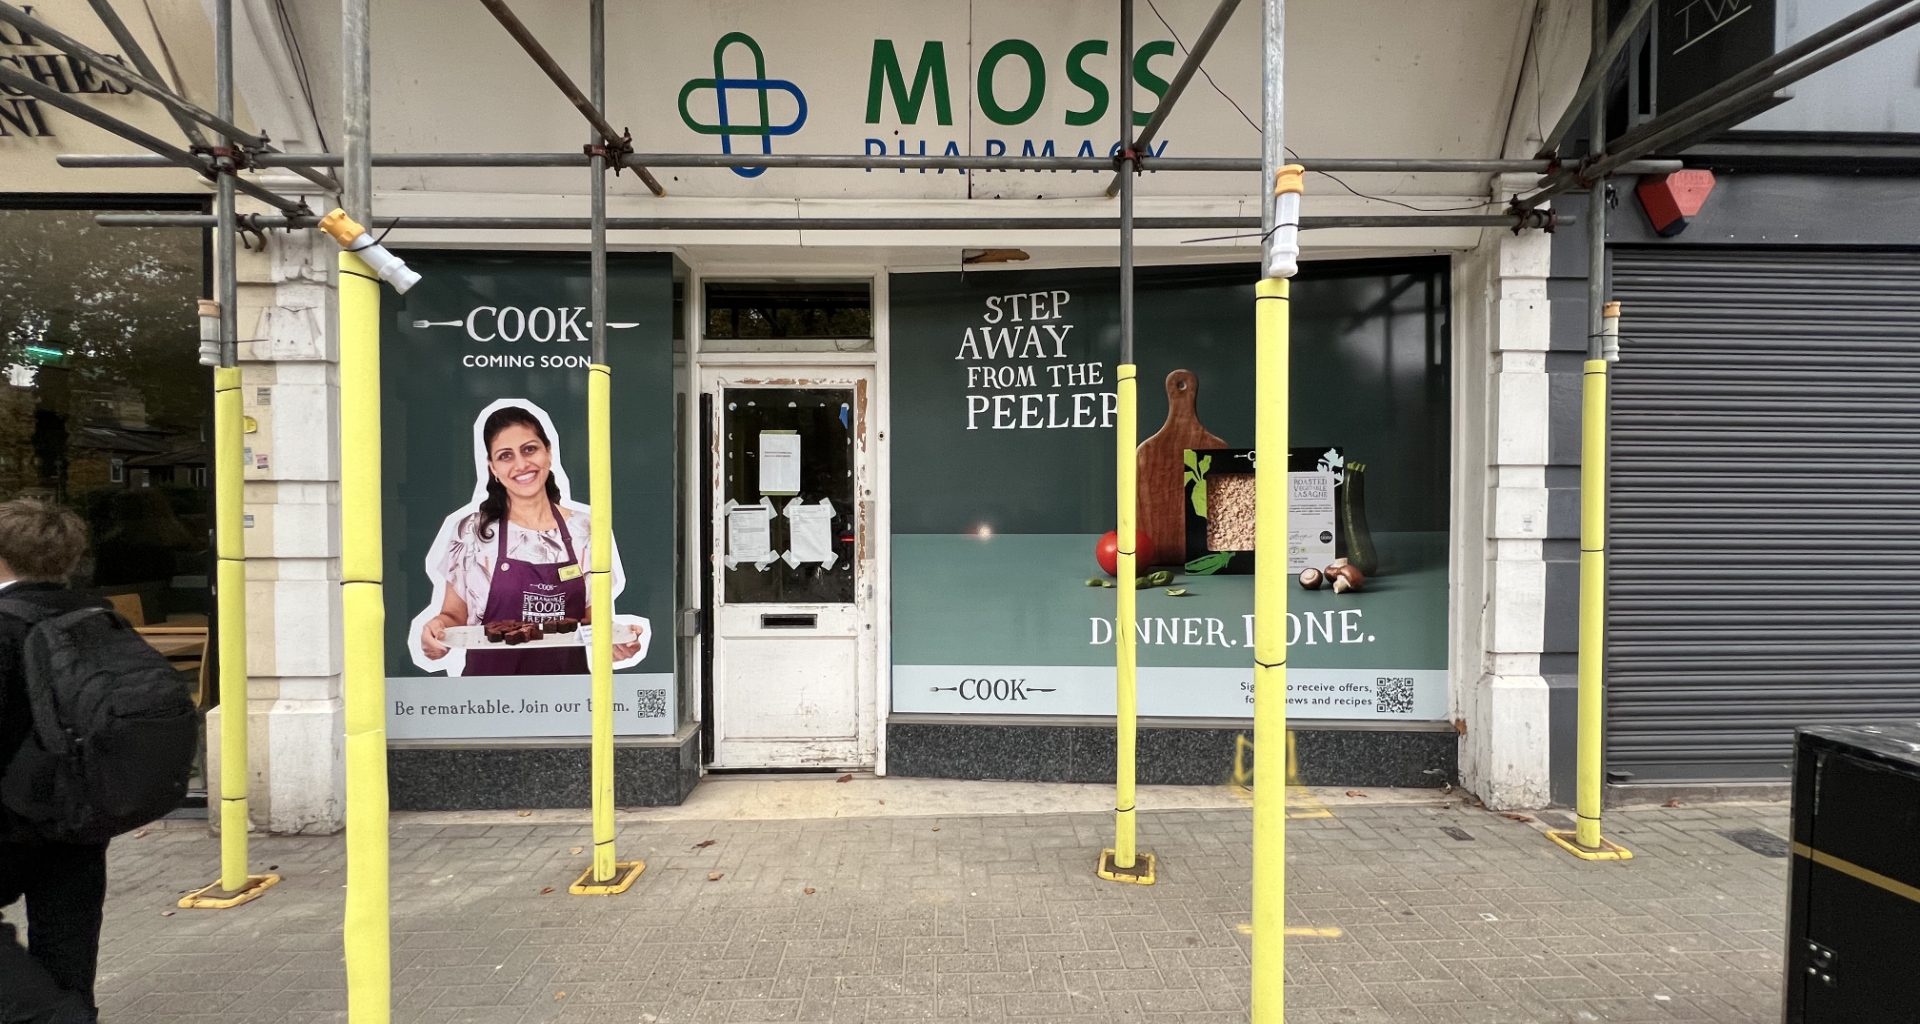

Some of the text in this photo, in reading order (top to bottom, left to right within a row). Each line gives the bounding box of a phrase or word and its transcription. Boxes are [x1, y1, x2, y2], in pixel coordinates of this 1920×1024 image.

[865, 38, 1176, 126] MOSS
[864, 138, 1169, 174] PHARMAY
[983, 290, 1071, 324] STEP
[466, 305, 589, 343] COOK
[955, 324, 1074, 360] AWAY
[462, 354, 592, 369] COMING SOON
[967, 362, 1104, 389] FROM THE
[966, 392, 1118, 430] PEELER
[529, 601, 561, 613] FOOD
[1089, 616, 1236, 648] DNNER.
[959, 678, 1028, 701] COOK
[1297, 682, 1335, 692] receive
[1338, 682, 1372, 693] offers,
[1311, 696, 1331, 705] and
[1334, 696, 1373, 707] recipes
[394, 697, 629, 716] Be remarkable. Join our tm.
